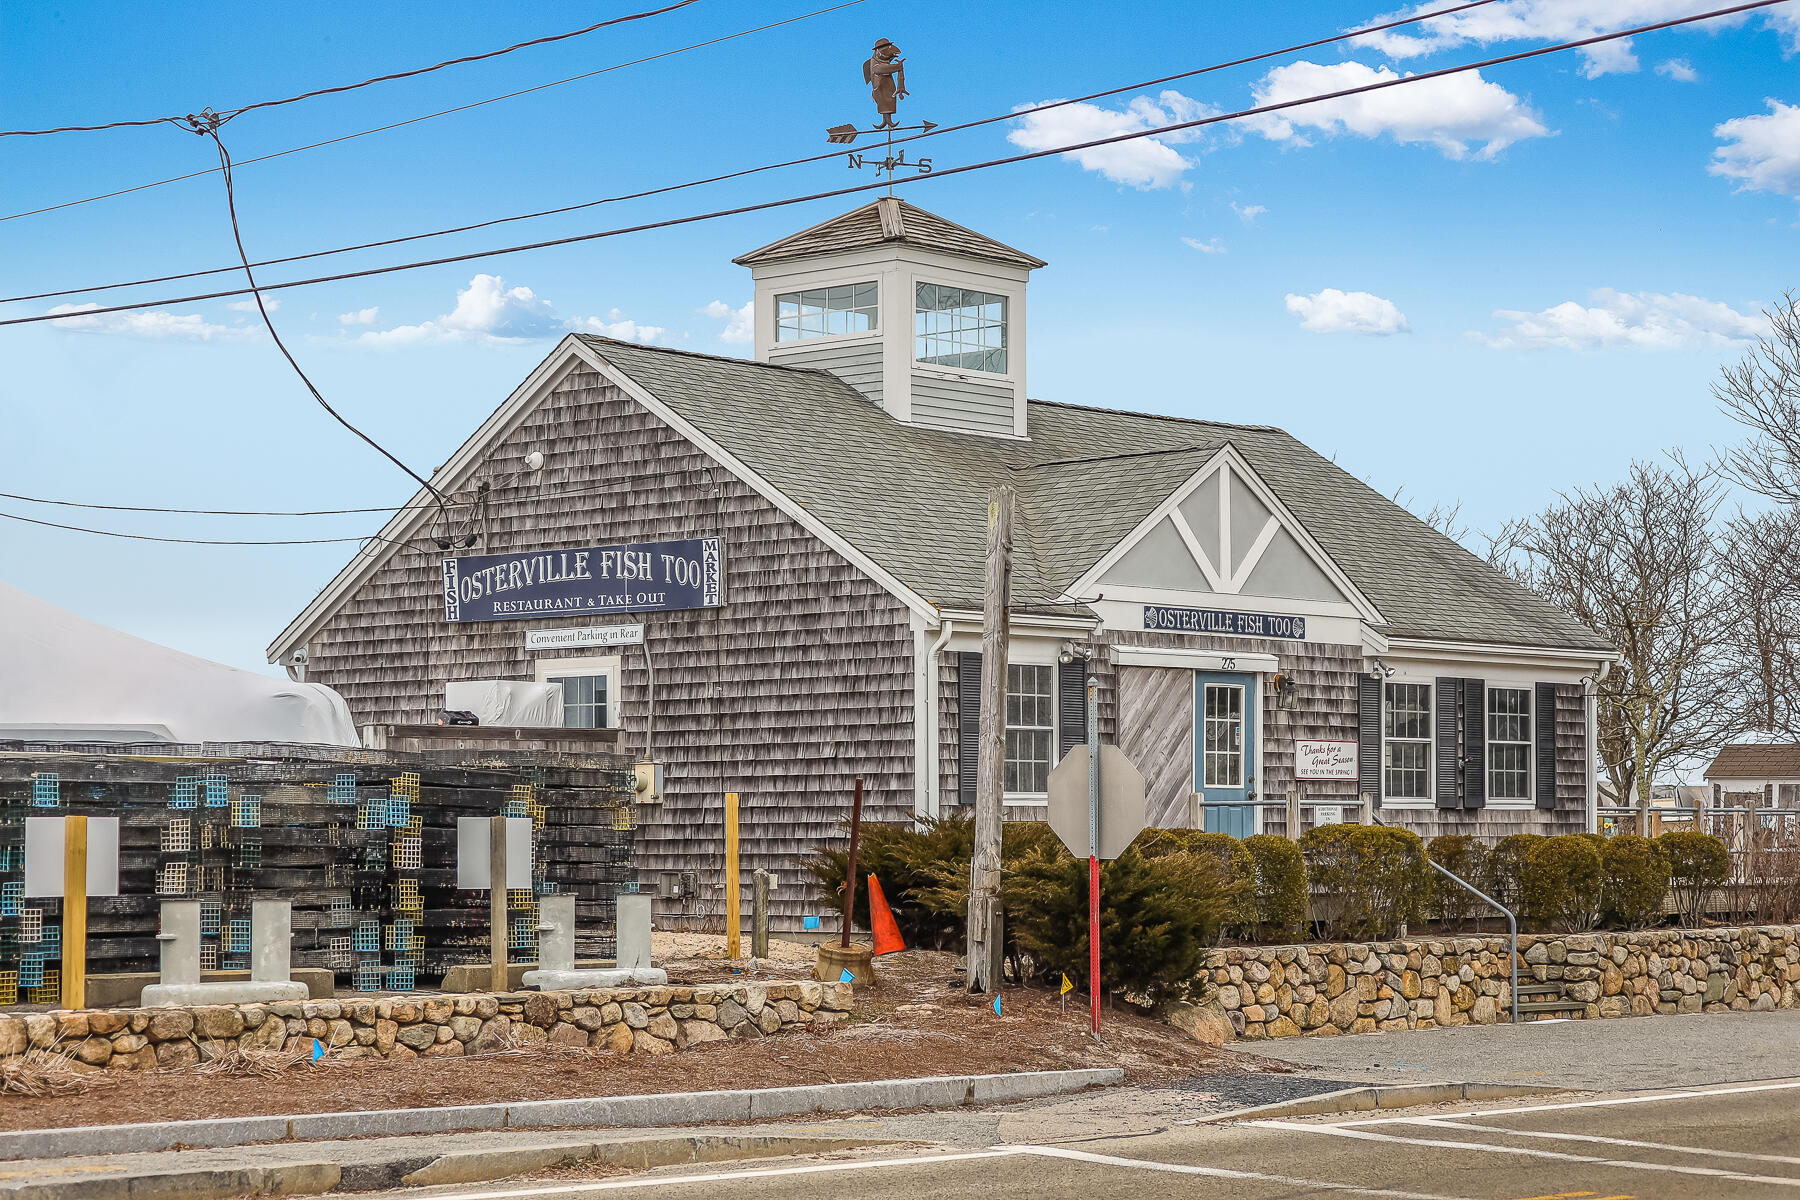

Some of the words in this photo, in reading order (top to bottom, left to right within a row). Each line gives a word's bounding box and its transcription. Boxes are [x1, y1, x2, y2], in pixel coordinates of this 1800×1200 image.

[848, 154, 863, 169] N
[918, 158, 932, 174] S
[461, 551, 592, 604] OSTERVILLE
[600, 550, 654, 581] FISH
[660, 553, 701, 589] TOO
[703, 540, 718, 605] MARKET
[444, 560, 459, 620] FISH
[493, 597, 583, 613] RESTAURANT
[587, 598, 595, 607] &
[598, 594, 633, 606] TAKE
[636, 592, 666, 603] OUT
[1158, 609, 1234, 632] OSTERVILLE
[1237, 615, 1264, 634] FISH
[1268, 617, 1291, 636] TOO
[530, 632, 576, 644] Convenient
[577, 629, 608, 643] Parking
[610, 628, 618, 638] in
[620, 627, 638, 639] Rear
[1221, 657, 1236, 670] 275
[1301, 744, 1325, 756] Thanks
[1326, 743, 1336, 756] for
[1312, 755, 1330, 767] Great
